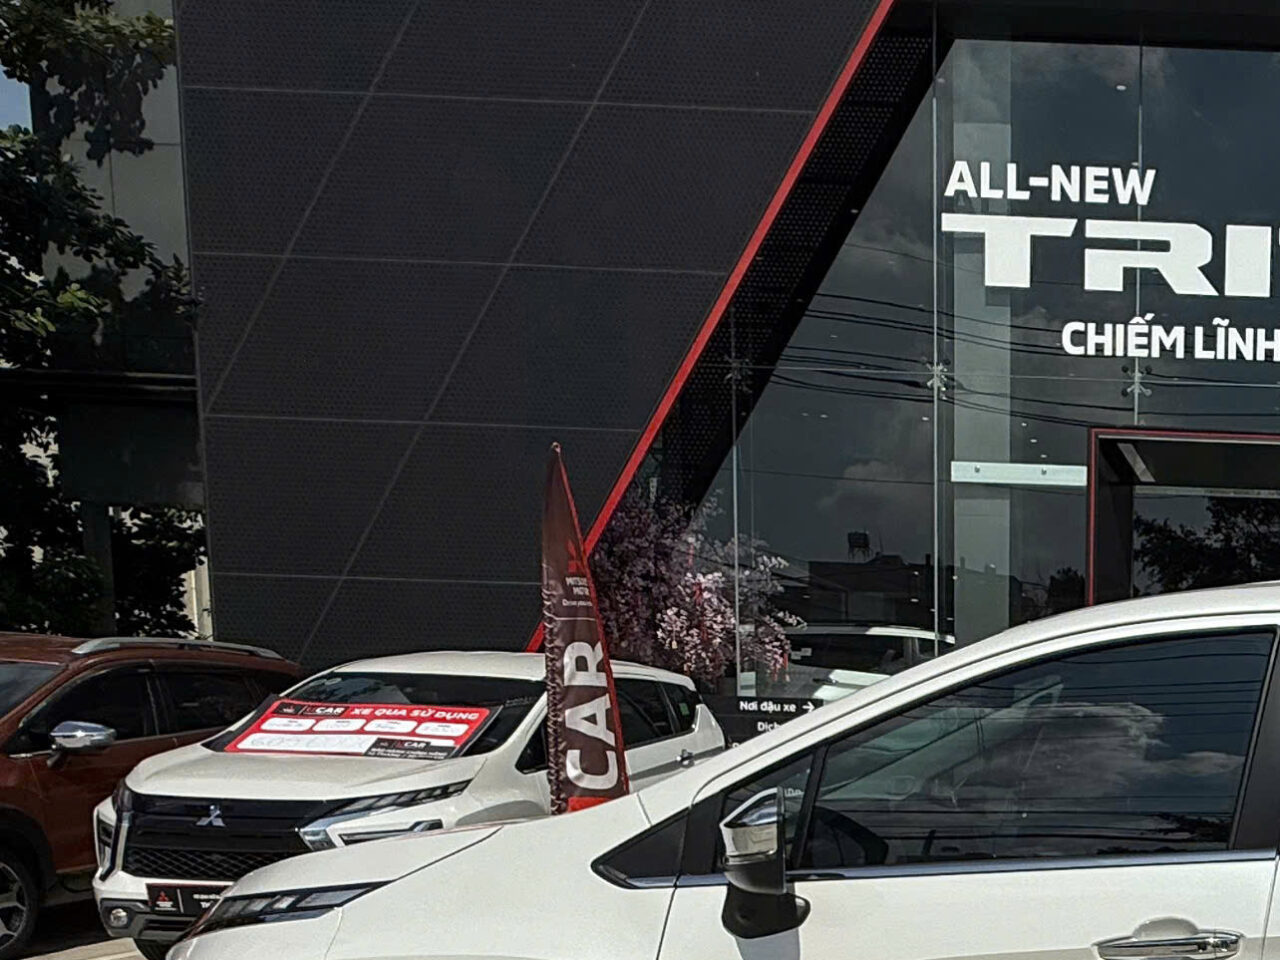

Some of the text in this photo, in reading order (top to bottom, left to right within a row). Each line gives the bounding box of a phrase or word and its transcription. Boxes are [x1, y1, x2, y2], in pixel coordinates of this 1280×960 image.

[944, 160, 1156, 206] ALL-NEW
[1061, 313, 1185, 359] CHIẾM
[351, 708, 373, 716] XE
[374, 709, 407, 717] QUA
[740, 701, 758, 711] Nơi
[760, 702, 780, 713] đậu
